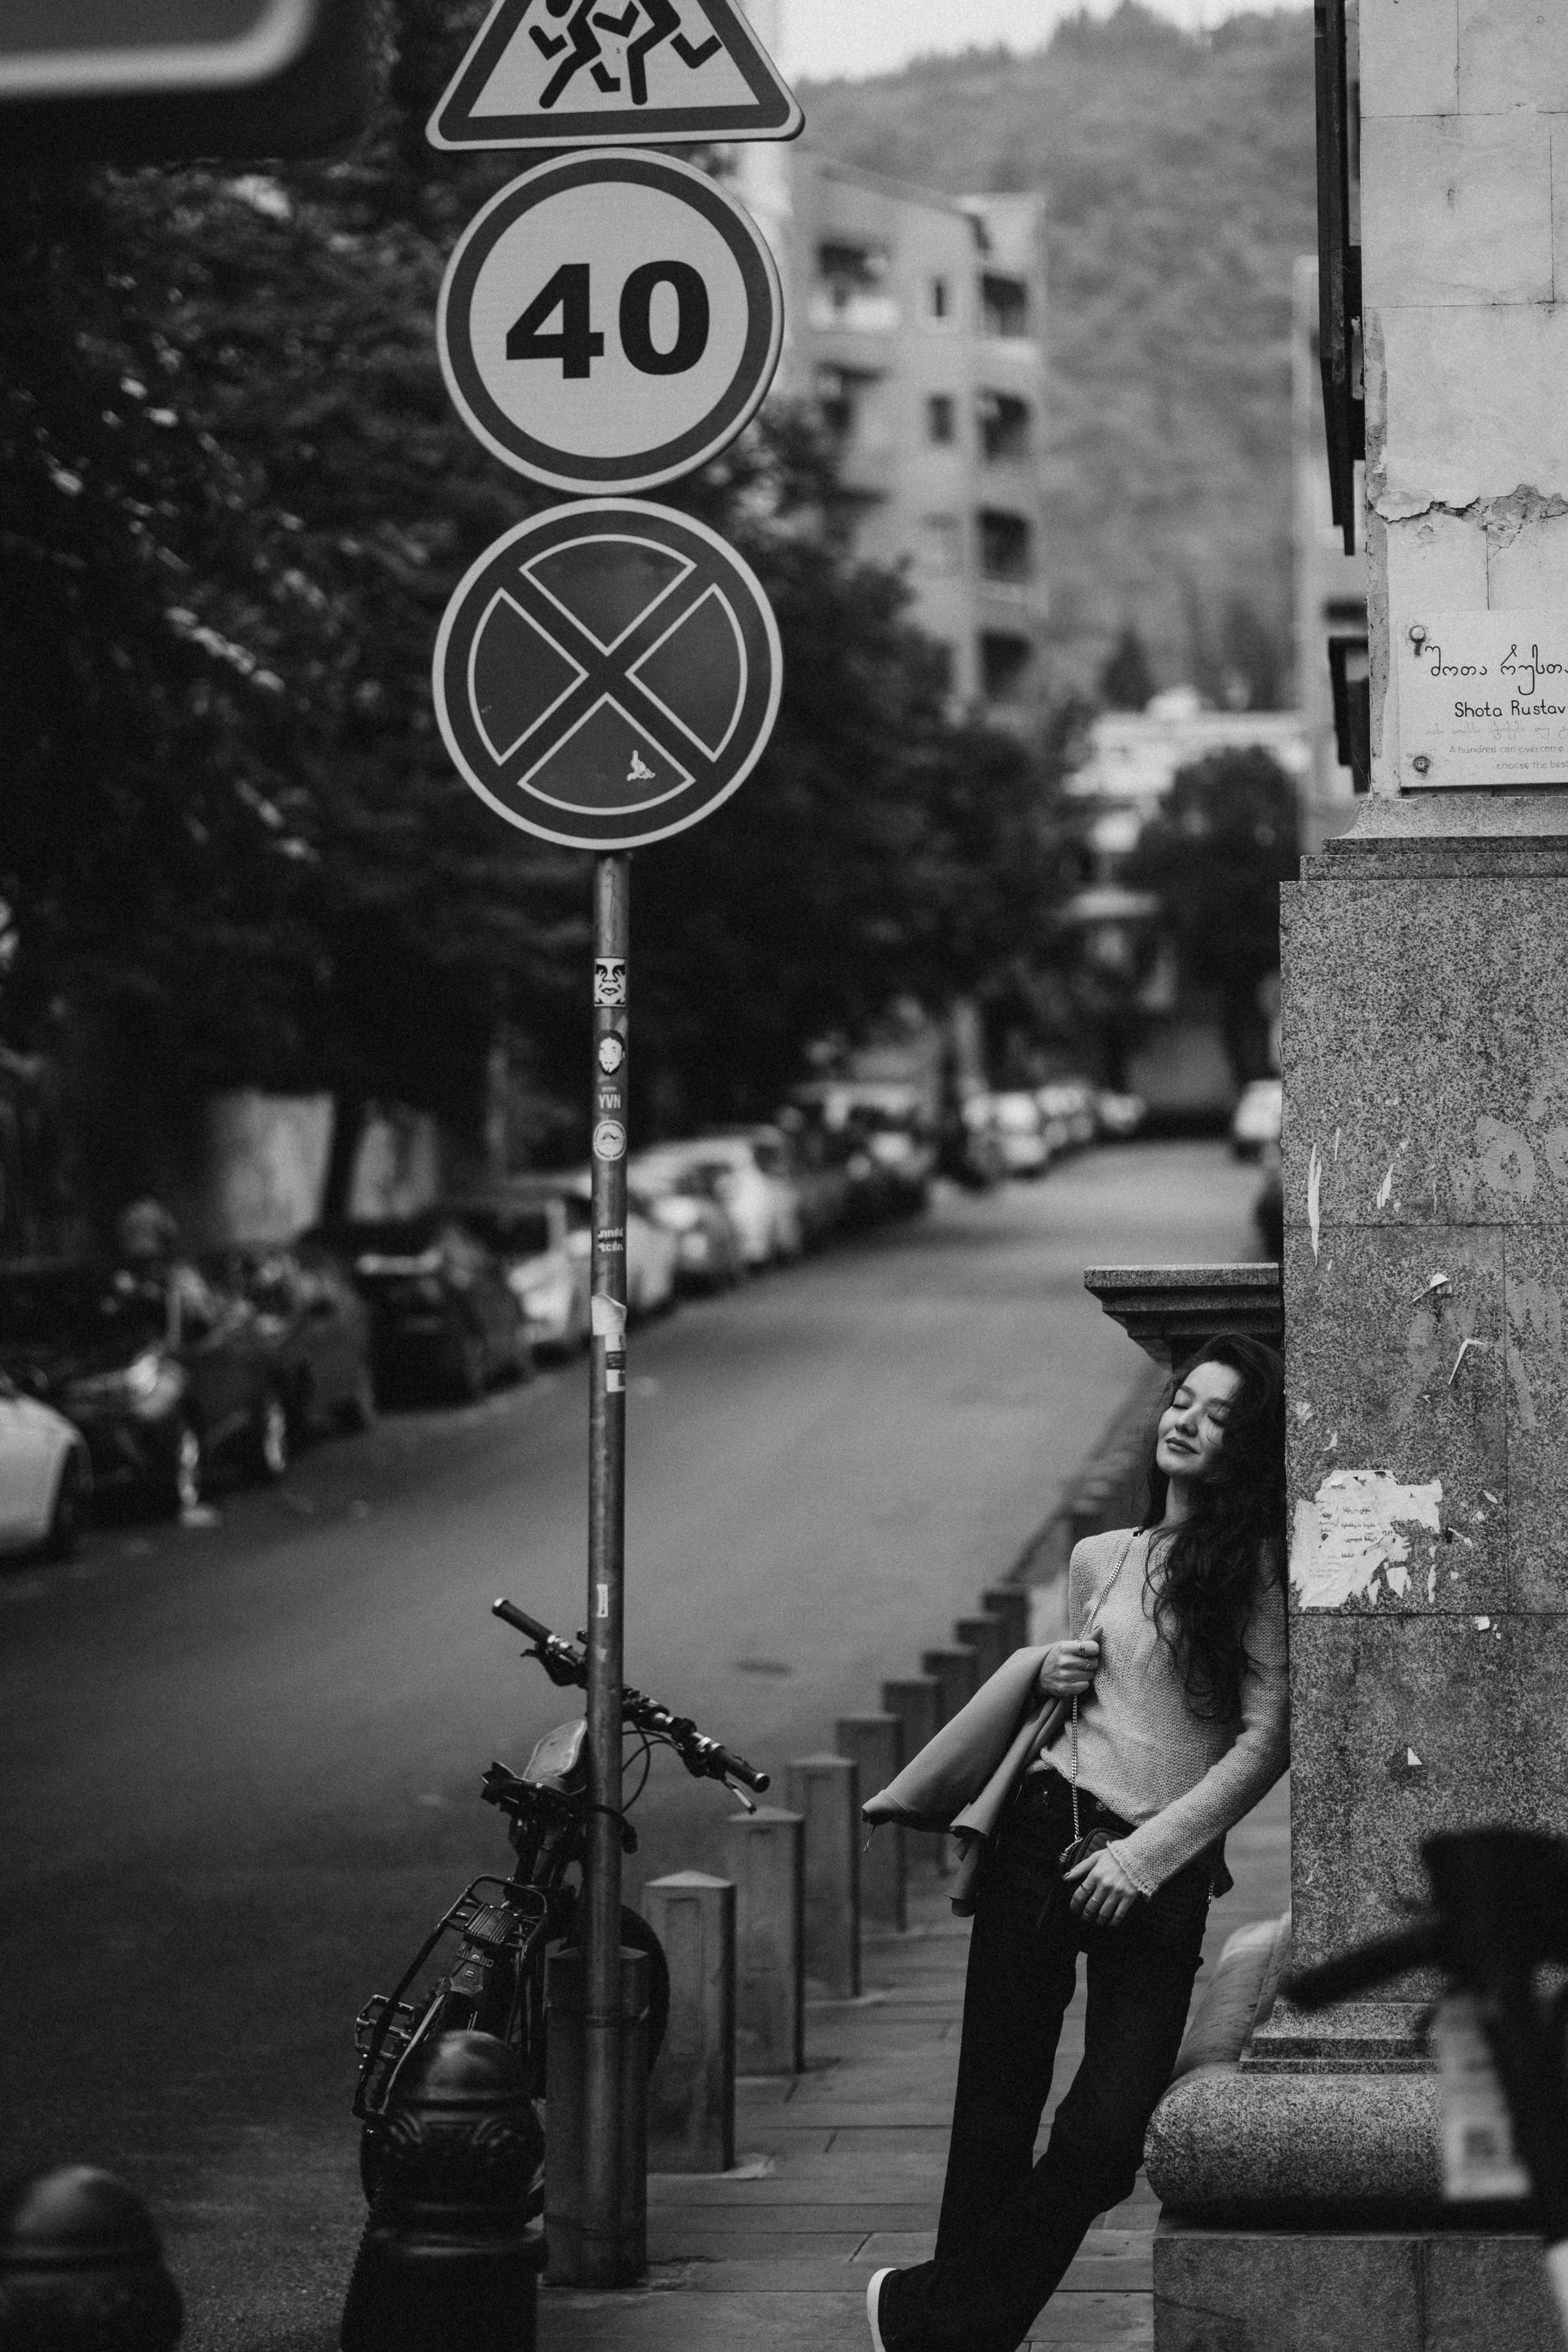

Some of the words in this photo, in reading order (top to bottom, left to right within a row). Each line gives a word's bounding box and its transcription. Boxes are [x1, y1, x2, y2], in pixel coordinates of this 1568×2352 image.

[506, 260, 710, 379] 40
[1425, 646, 1487, 676] შოთა
[1455, 701, 1503, 717] Shota
[1511, 699, 1566, 715] Rustav
[1458, 745, 1496, 753] hundred
